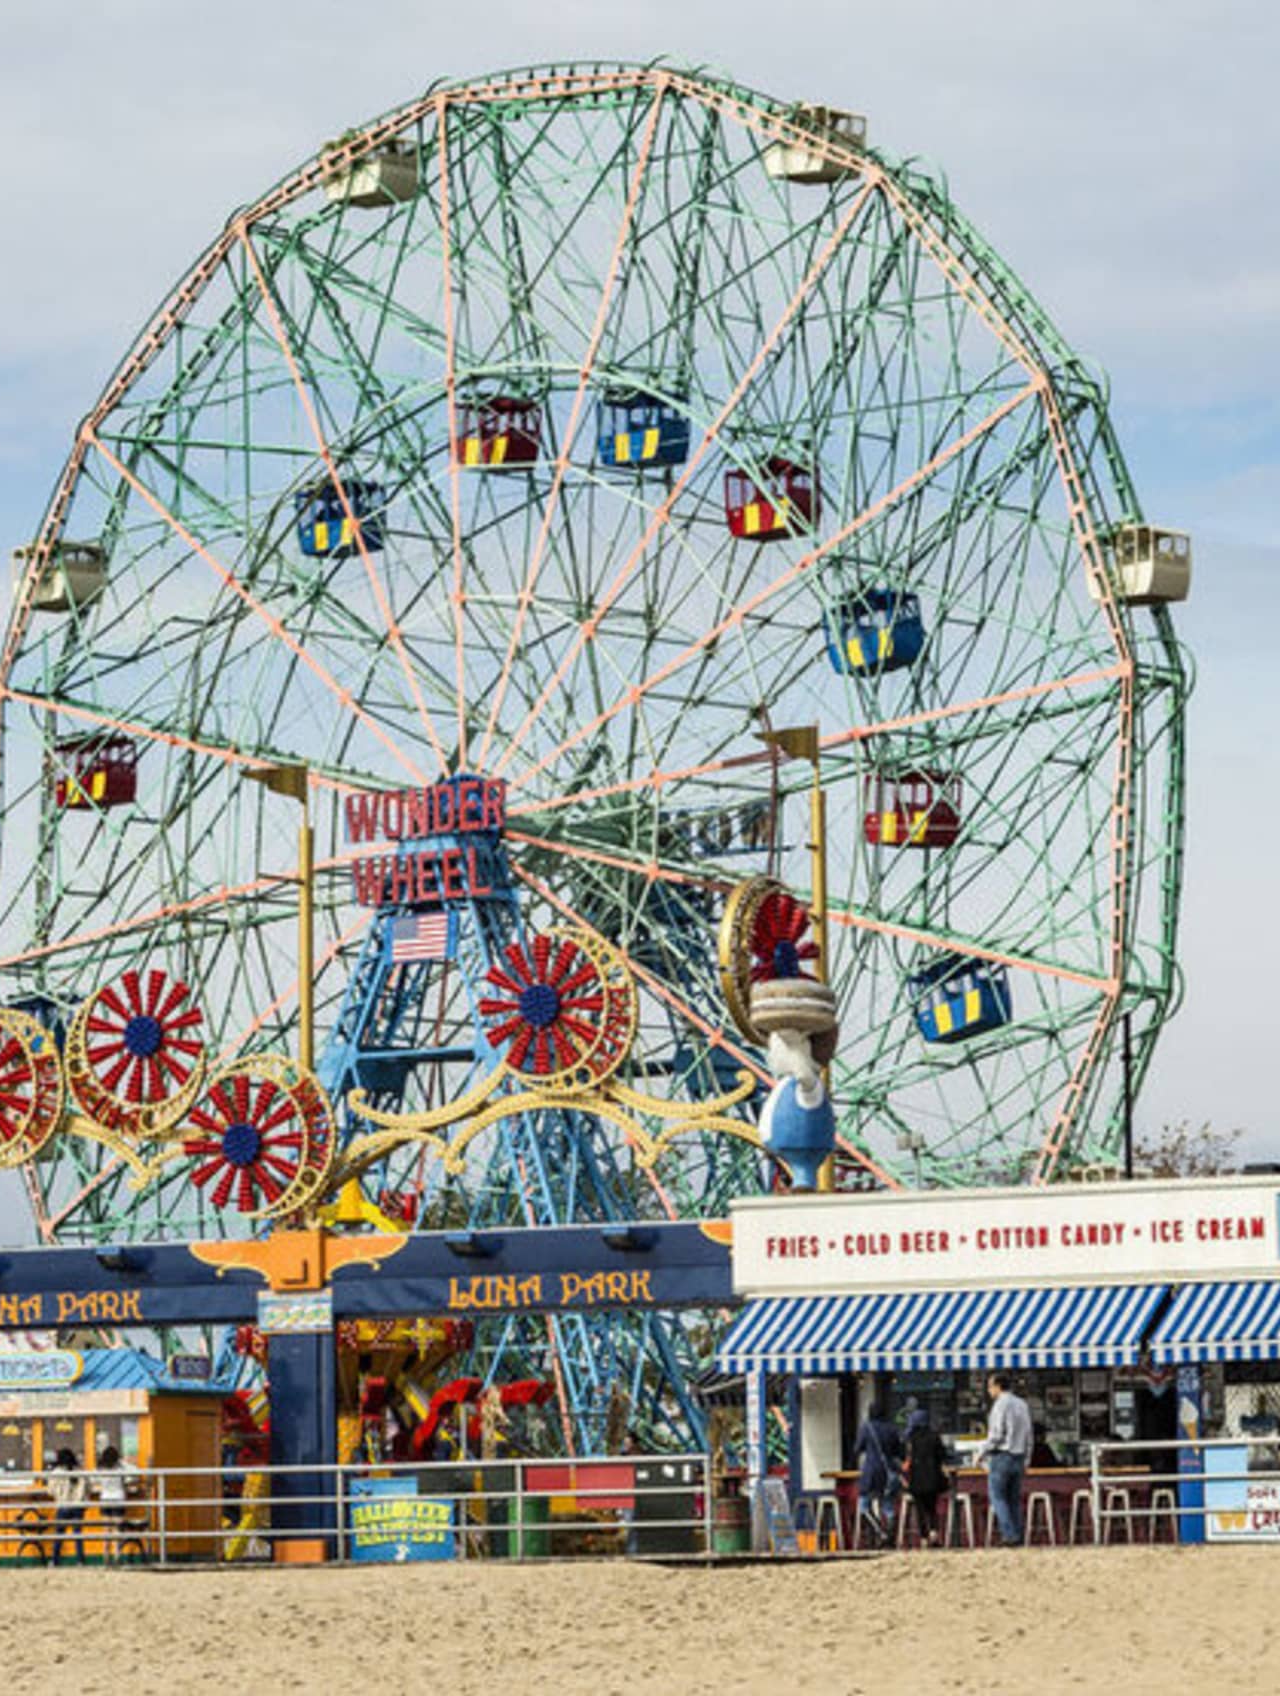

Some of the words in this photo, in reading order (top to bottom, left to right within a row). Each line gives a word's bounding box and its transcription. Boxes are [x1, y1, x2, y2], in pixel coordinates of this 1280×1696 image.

[345, 778, 506, 843] WONDER
[352, 846, 492, 906] WHEEL
[767, 1236, 819, 1257] FRIES
[845, 1233, 889, 1255] COLD
[901, 1231, 949, 1252] BEER
[977, 1226, 1049, 1249] COTTON
[1061, 1223, 1124, 1246] CANDY
[1151, 1220, 1183, 1242] ICE
[1197, 1217, 1264, 1240] CREAM
[57, 1291, 143, 1321] PARK
[449, 1276, 541, 1308] LUNA
[560, 1270, 653, 1304] PARK
